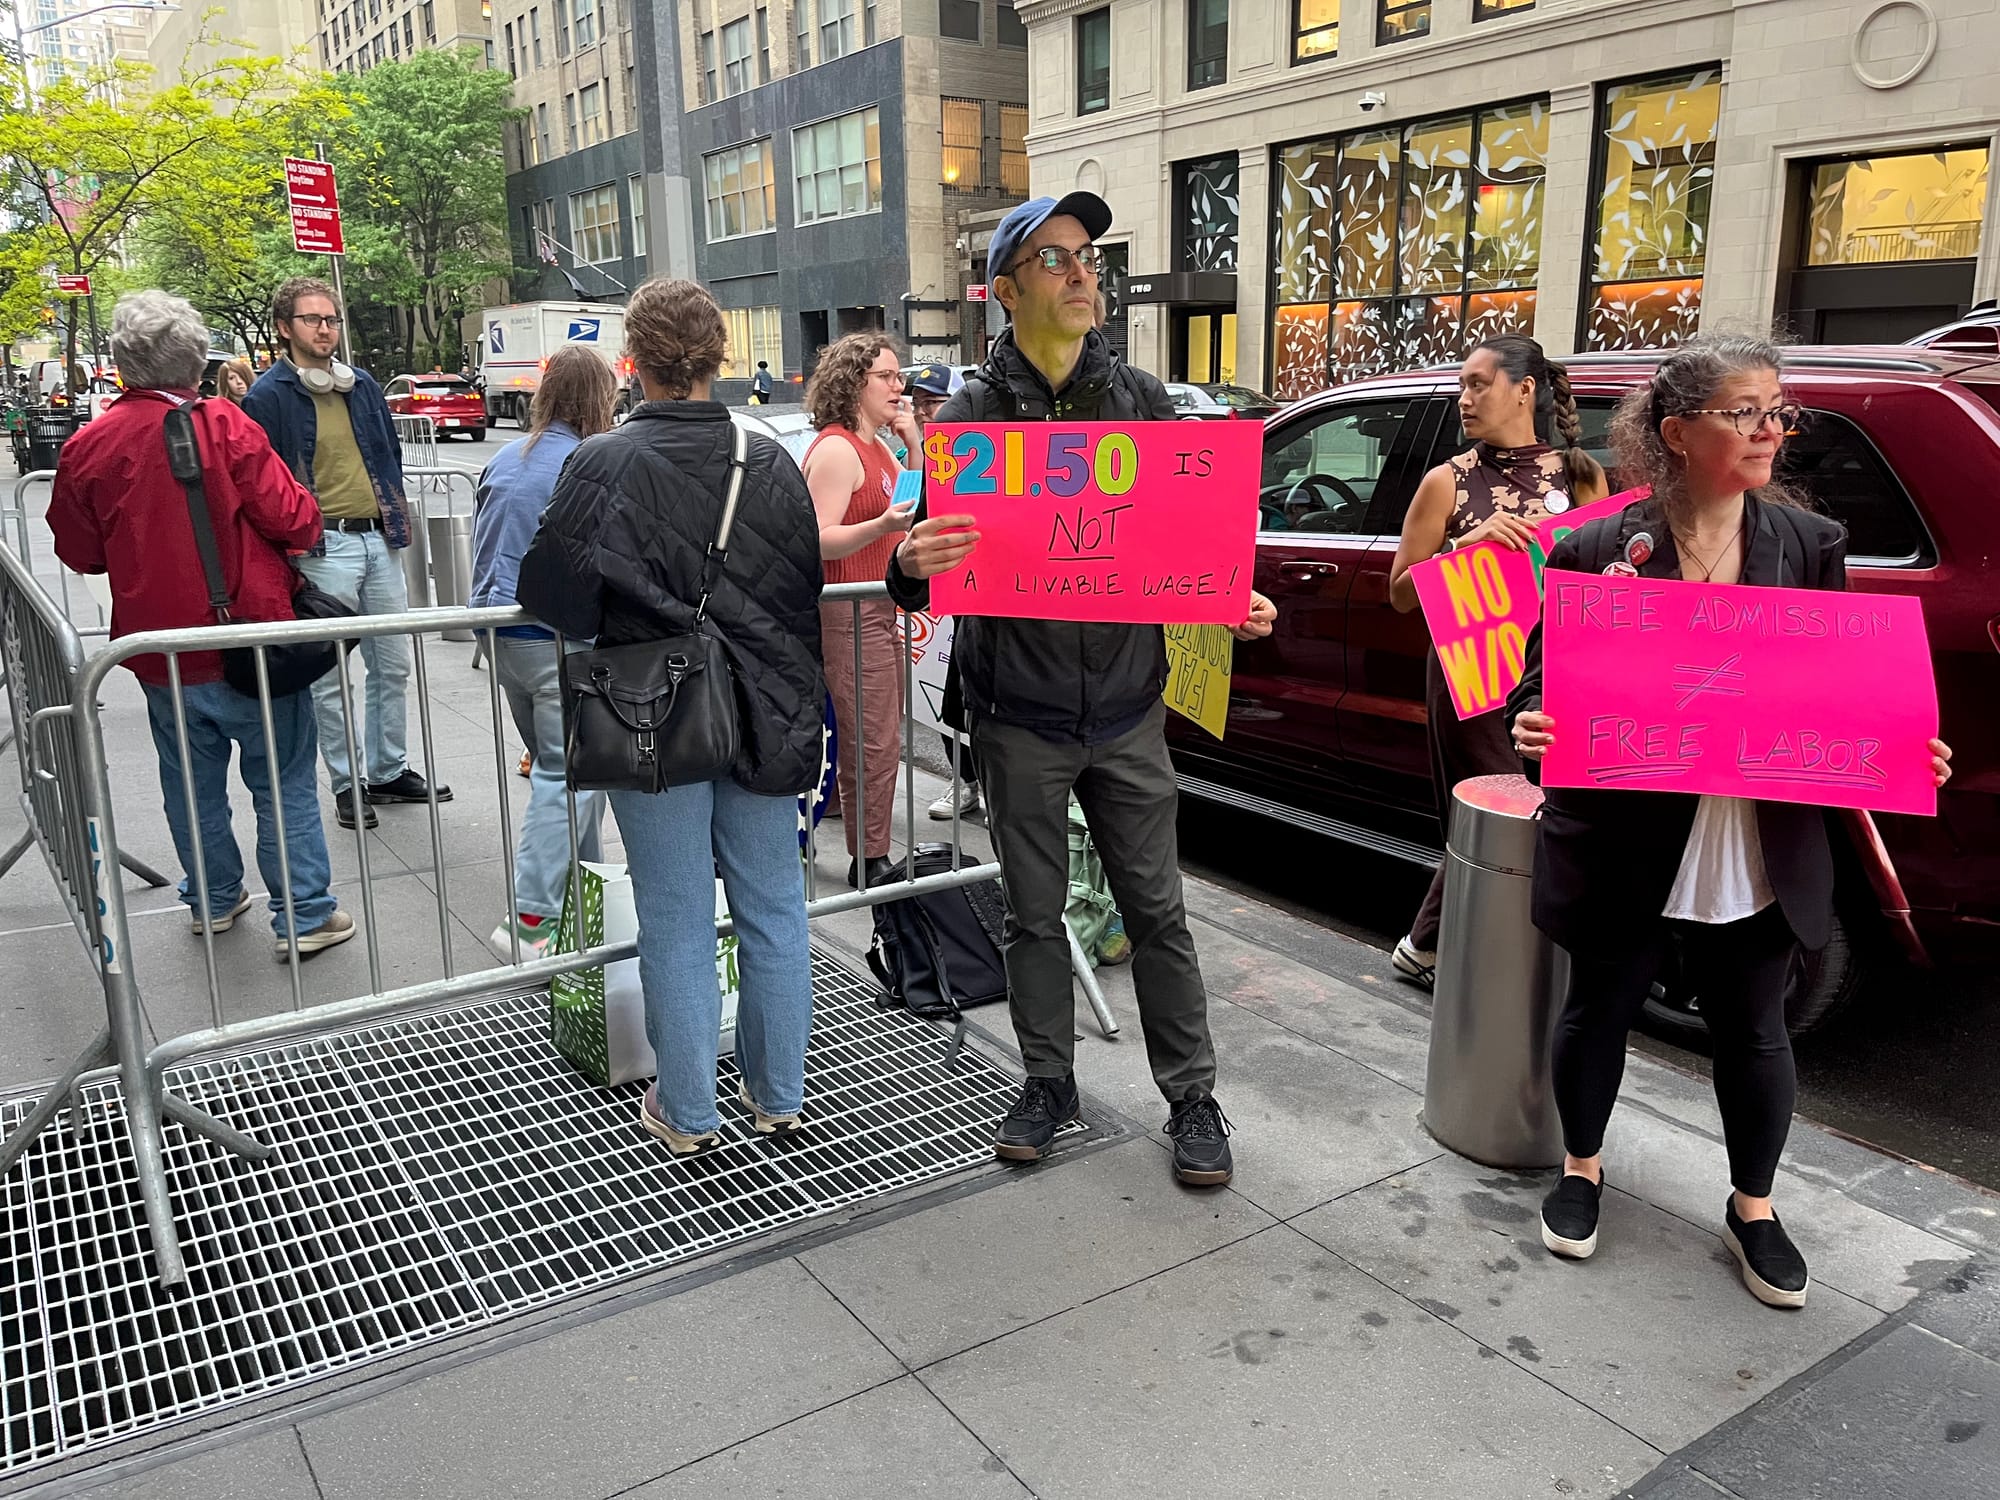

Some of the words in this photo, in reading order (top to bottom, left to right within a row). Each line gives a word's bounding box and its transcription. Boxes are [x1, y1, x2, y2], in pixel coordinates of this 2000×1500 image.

[287, 163, 297, 172] NO
[298, 165, 326, 176] STANDING
[290, 174, 314, 185] Anytime
[292, 207, 303, 217] NO
[304, 209, 332, 219] STANDING
[925, 430, 1139, 497] $21.50
[1172, 449, 1215, 478] IS
[1047, 503, 1134, 554] NOT
[963, 569, 978, 593] A
[1014, 572, 1125, 596] LIVABLE
[1438, 547, 1513, 629] NO
[1555, 583, 1666, 632] FREE
[1688, 596, 1894, 640] ADMISSION
[1587, 714, 1709, 762] FREE
[1735, 727, 1888, 779] LABOR
